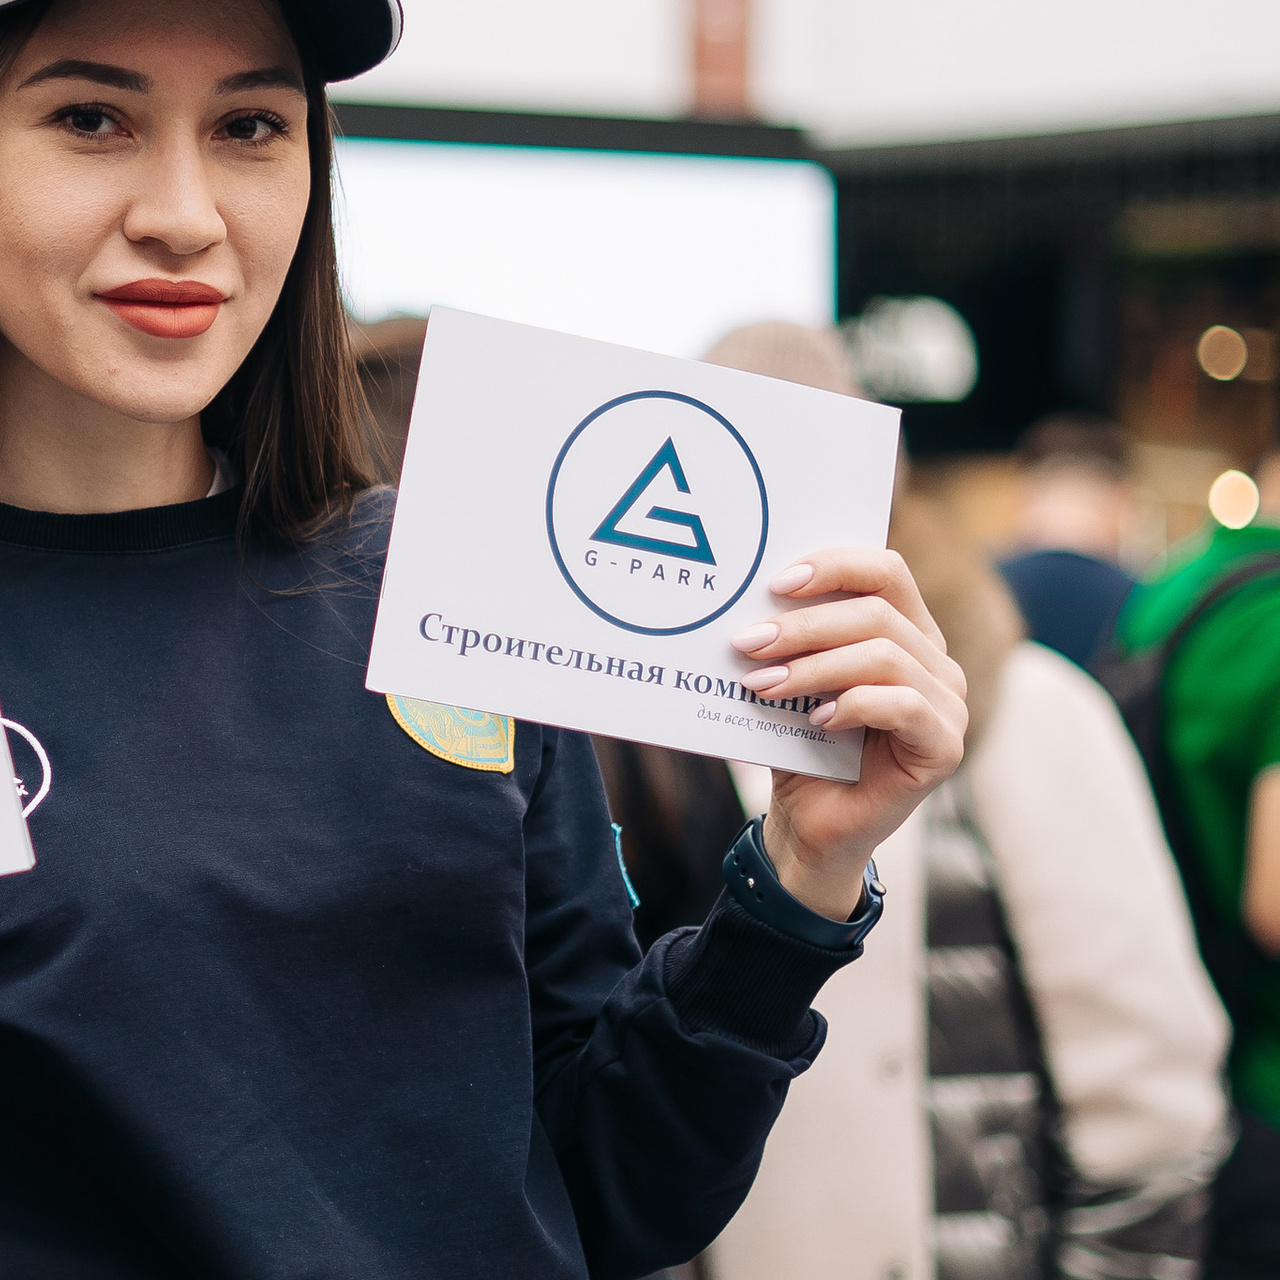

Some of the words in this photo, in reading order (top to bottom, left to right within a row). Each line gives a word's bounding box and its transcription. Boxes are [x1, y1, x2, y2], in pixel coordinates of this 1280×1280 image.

[584, 549, 718, 591] G-PARK
[418, 611, 666, 686] Строительная
[696, 703, 721, 722] для
[724, 713, 753, 730] всех
